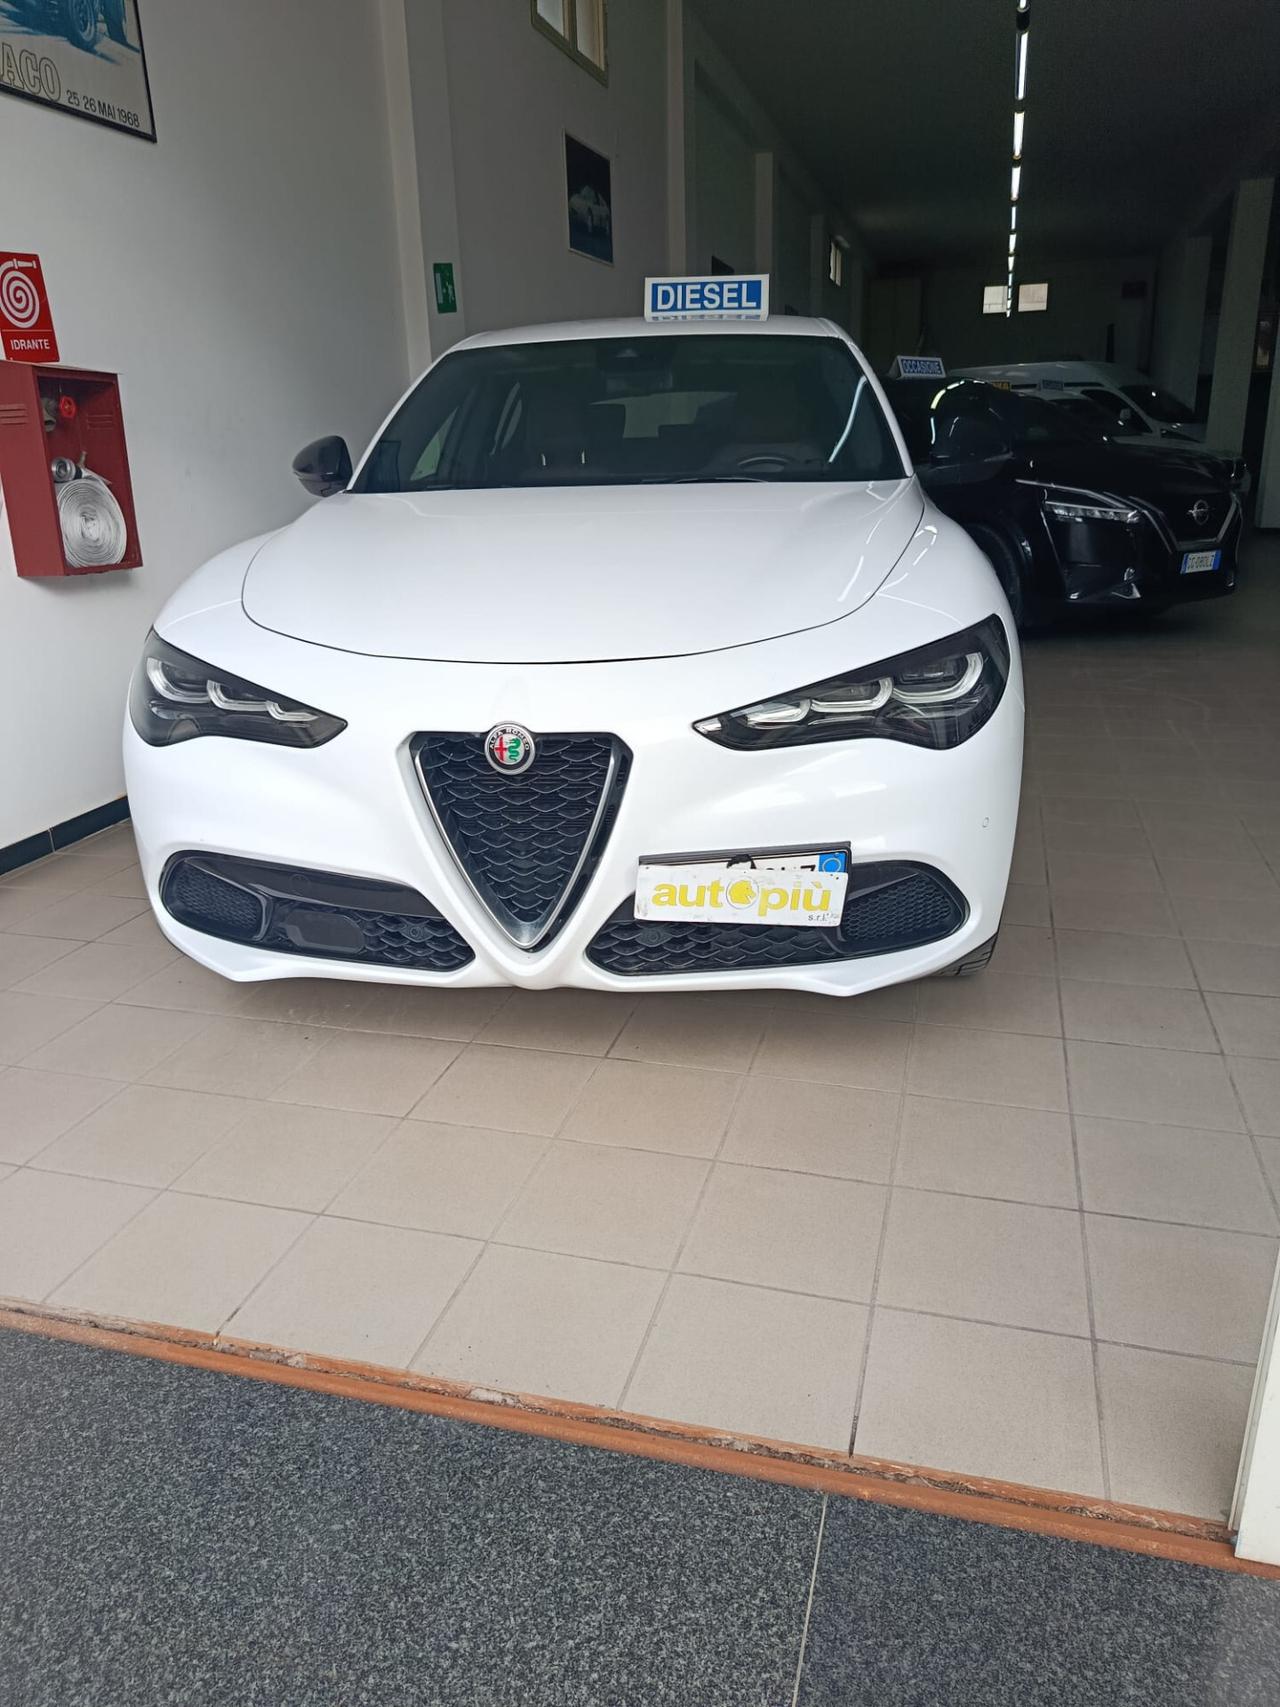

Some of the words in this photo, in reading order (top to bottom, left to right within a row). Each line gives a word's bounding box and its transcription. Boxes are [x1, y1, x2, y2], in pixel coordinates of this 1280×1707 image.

[66, 89, 80, 107] 25
[83, 95, 97, 113] 26
[98, 101, 116, 120] MAI
[117, 107, 140, 129] 1968
[657, 283, 757, 310] DIESEL
[10, 338, 51, 350] IDRANTE
[489, 731, 504, 750] ALFA
[506, 728, 530, 751] ROMEO
